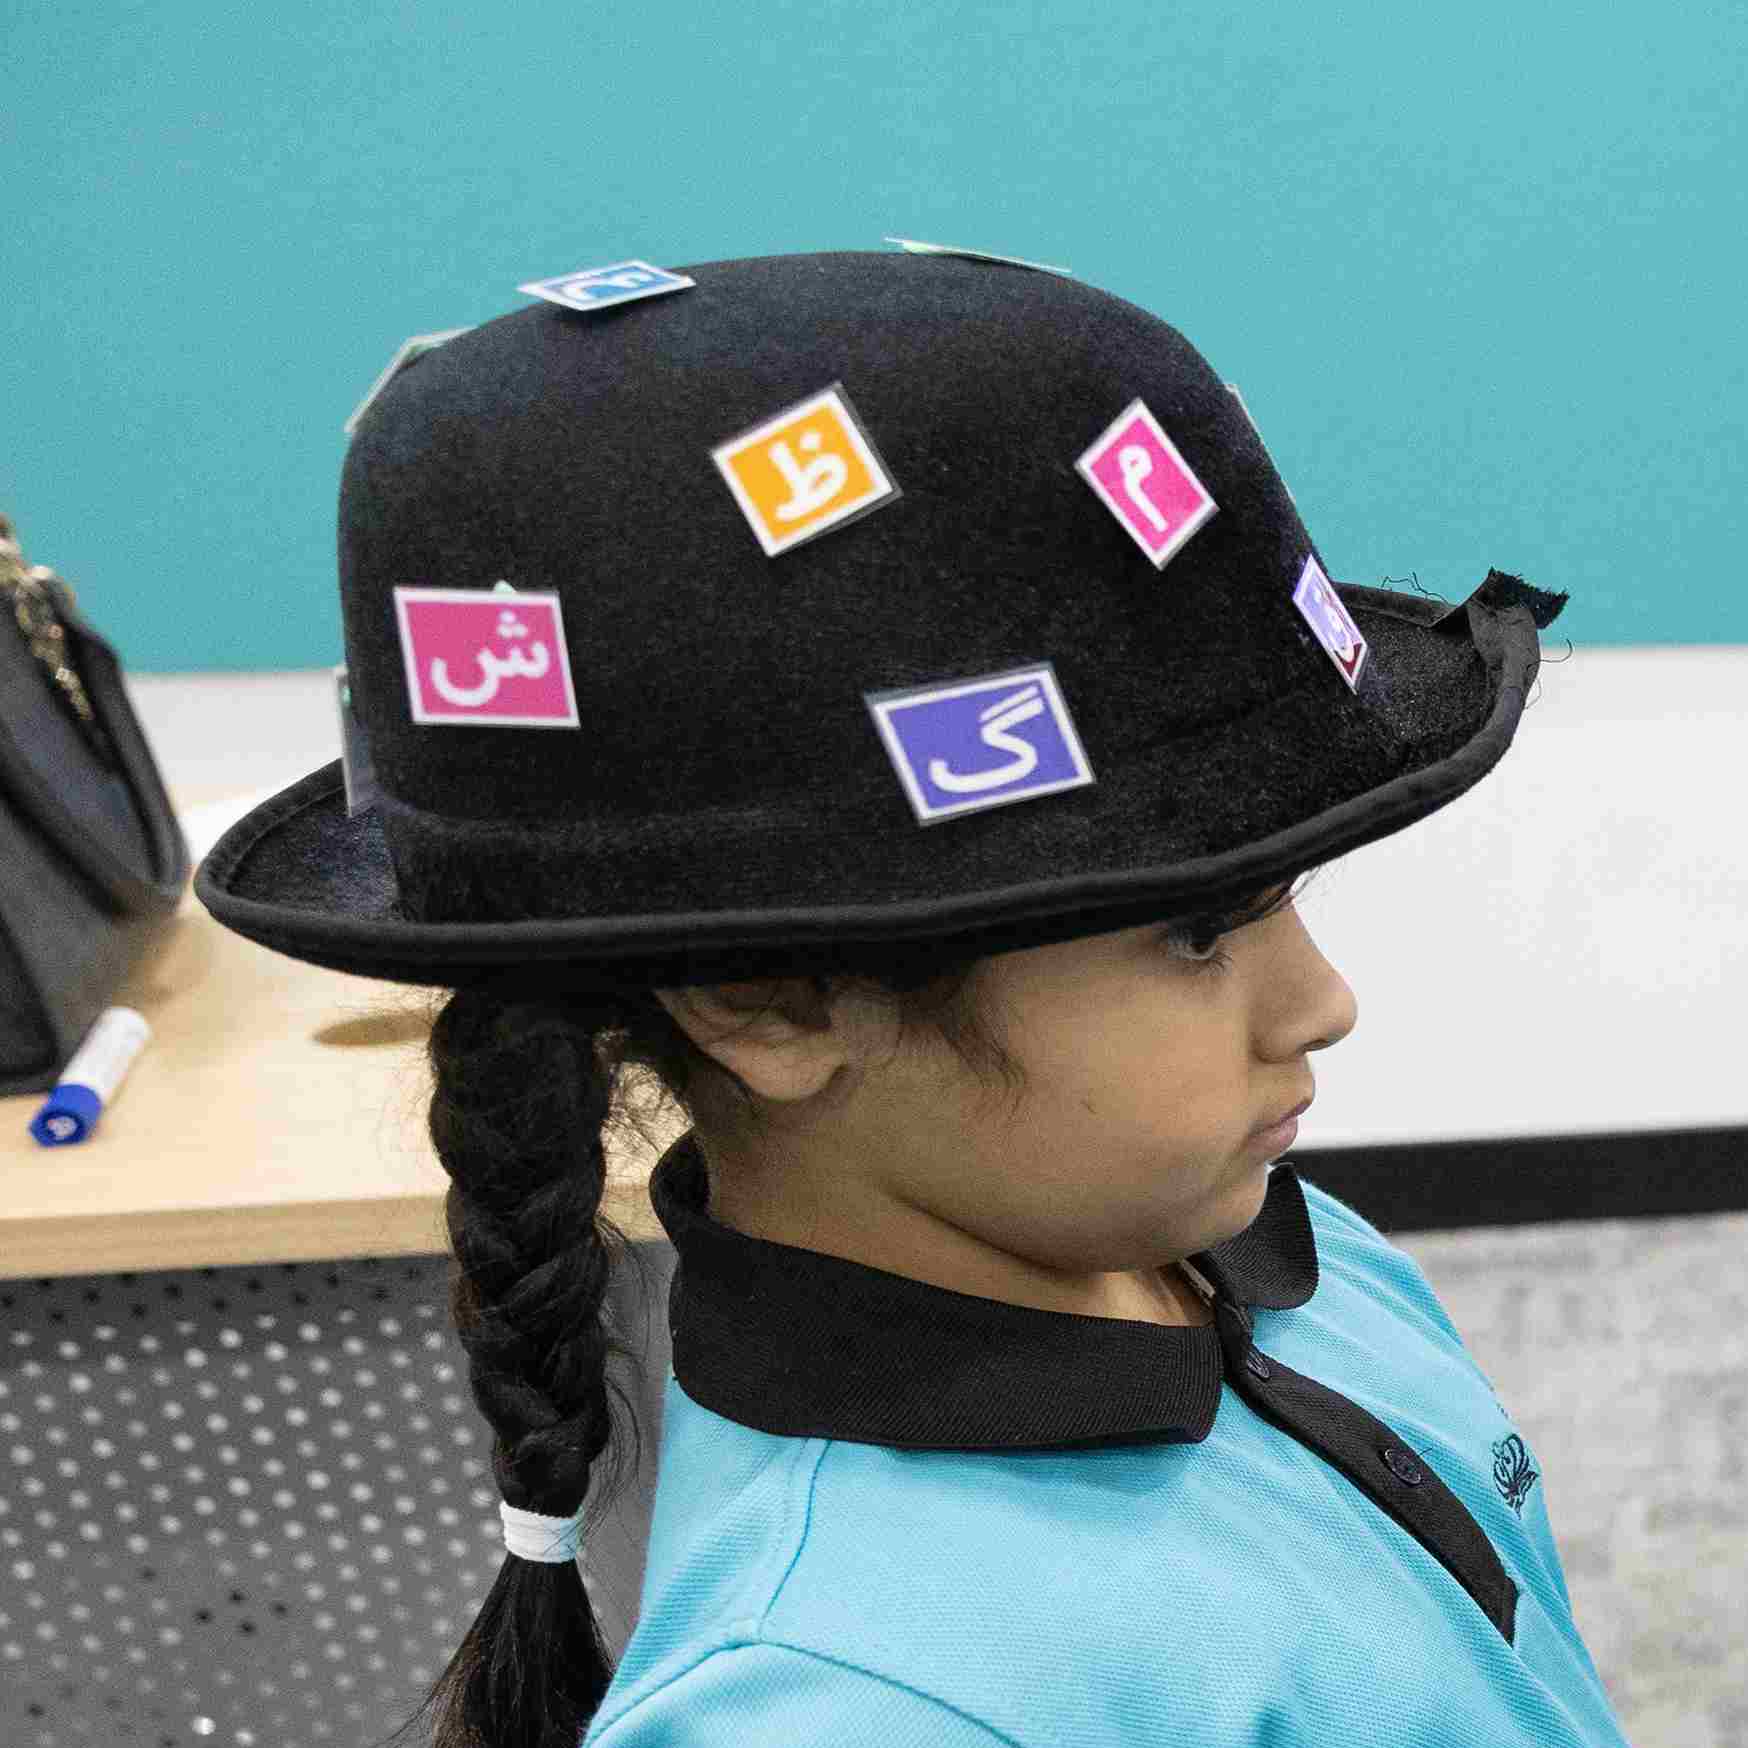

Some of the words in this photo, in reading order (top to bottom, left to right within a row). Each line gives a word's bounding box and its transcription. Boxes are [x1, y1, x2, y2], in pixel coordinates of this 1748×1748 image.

[768, 430, 848, 523] ظ
[1118, 444, 1169, 534] م
[430, 609, 550, 707] ش
